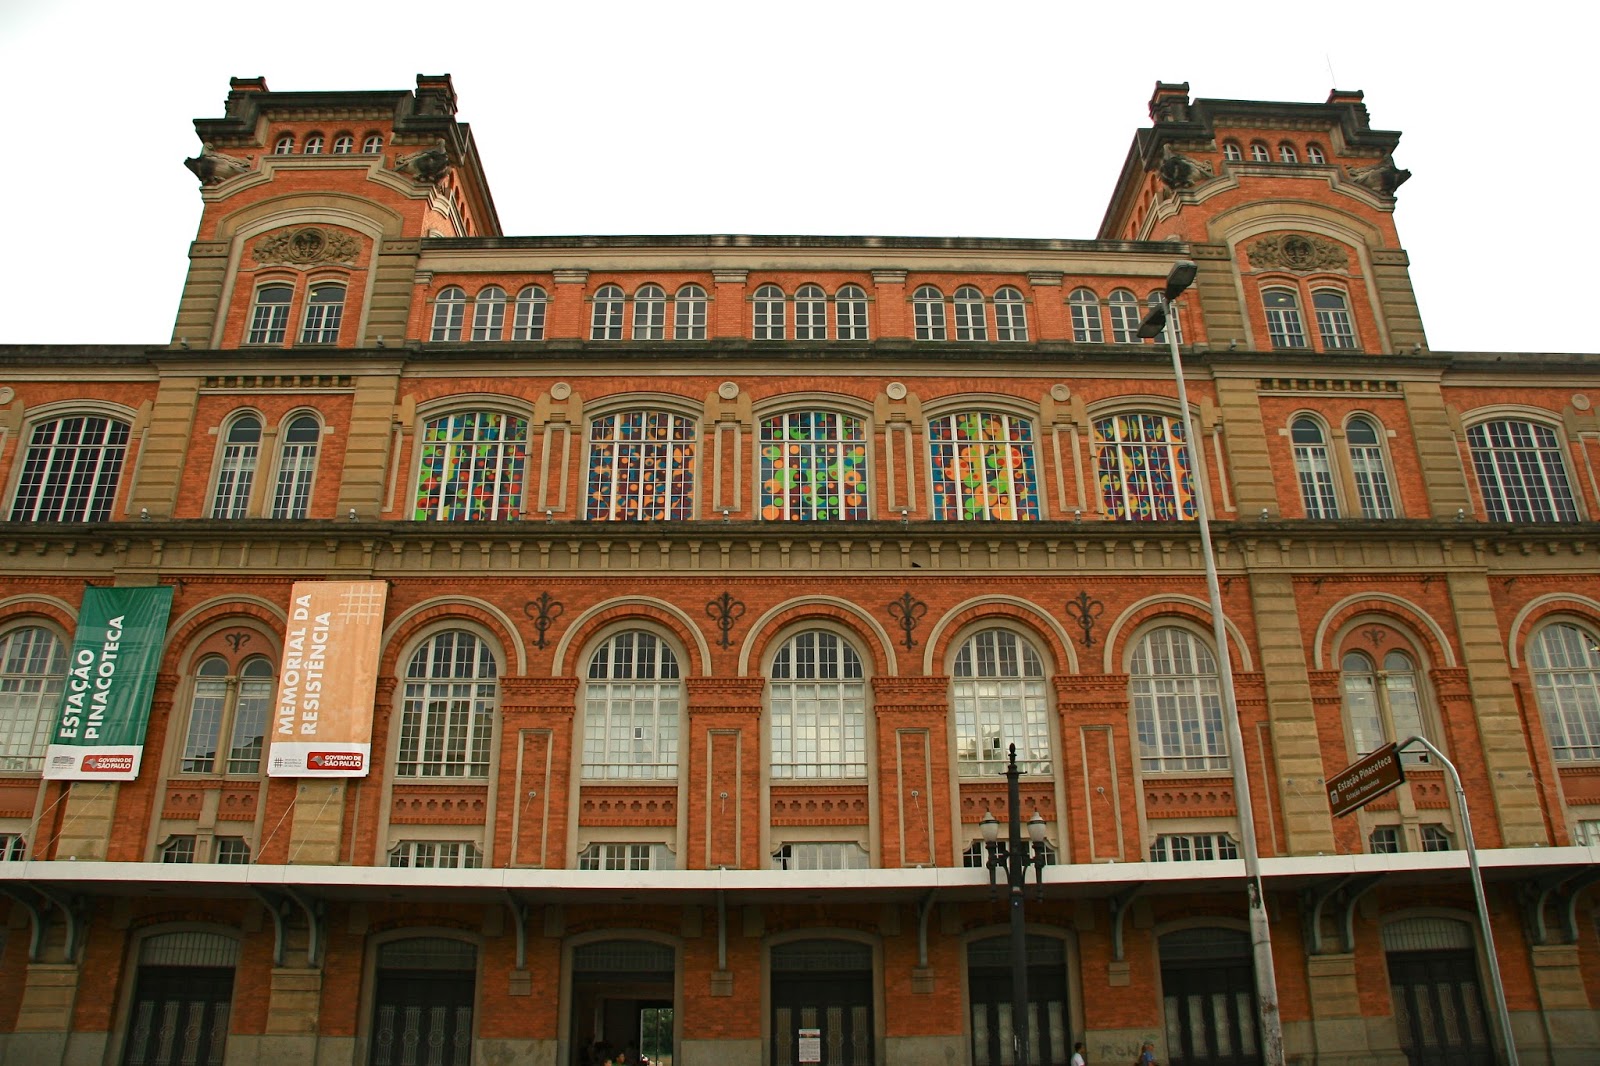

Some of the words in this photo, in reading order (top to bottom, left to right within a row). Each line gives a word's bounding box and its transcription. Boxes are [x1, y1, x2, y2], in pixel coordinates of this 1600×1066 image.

[60, 649, 95, 738] ESTAÇÃO
[84, 615, 125, 739] PINACOTECA
[278, 627, 307, 735] MEMORIAL
[293, 594, 312, 621] DA
[300, 611, 332, 735] RESISTÊNCIA
[1337, 774, 1359, 792] Estação
[1358, 755, 1392, 779] Pinacoteca
